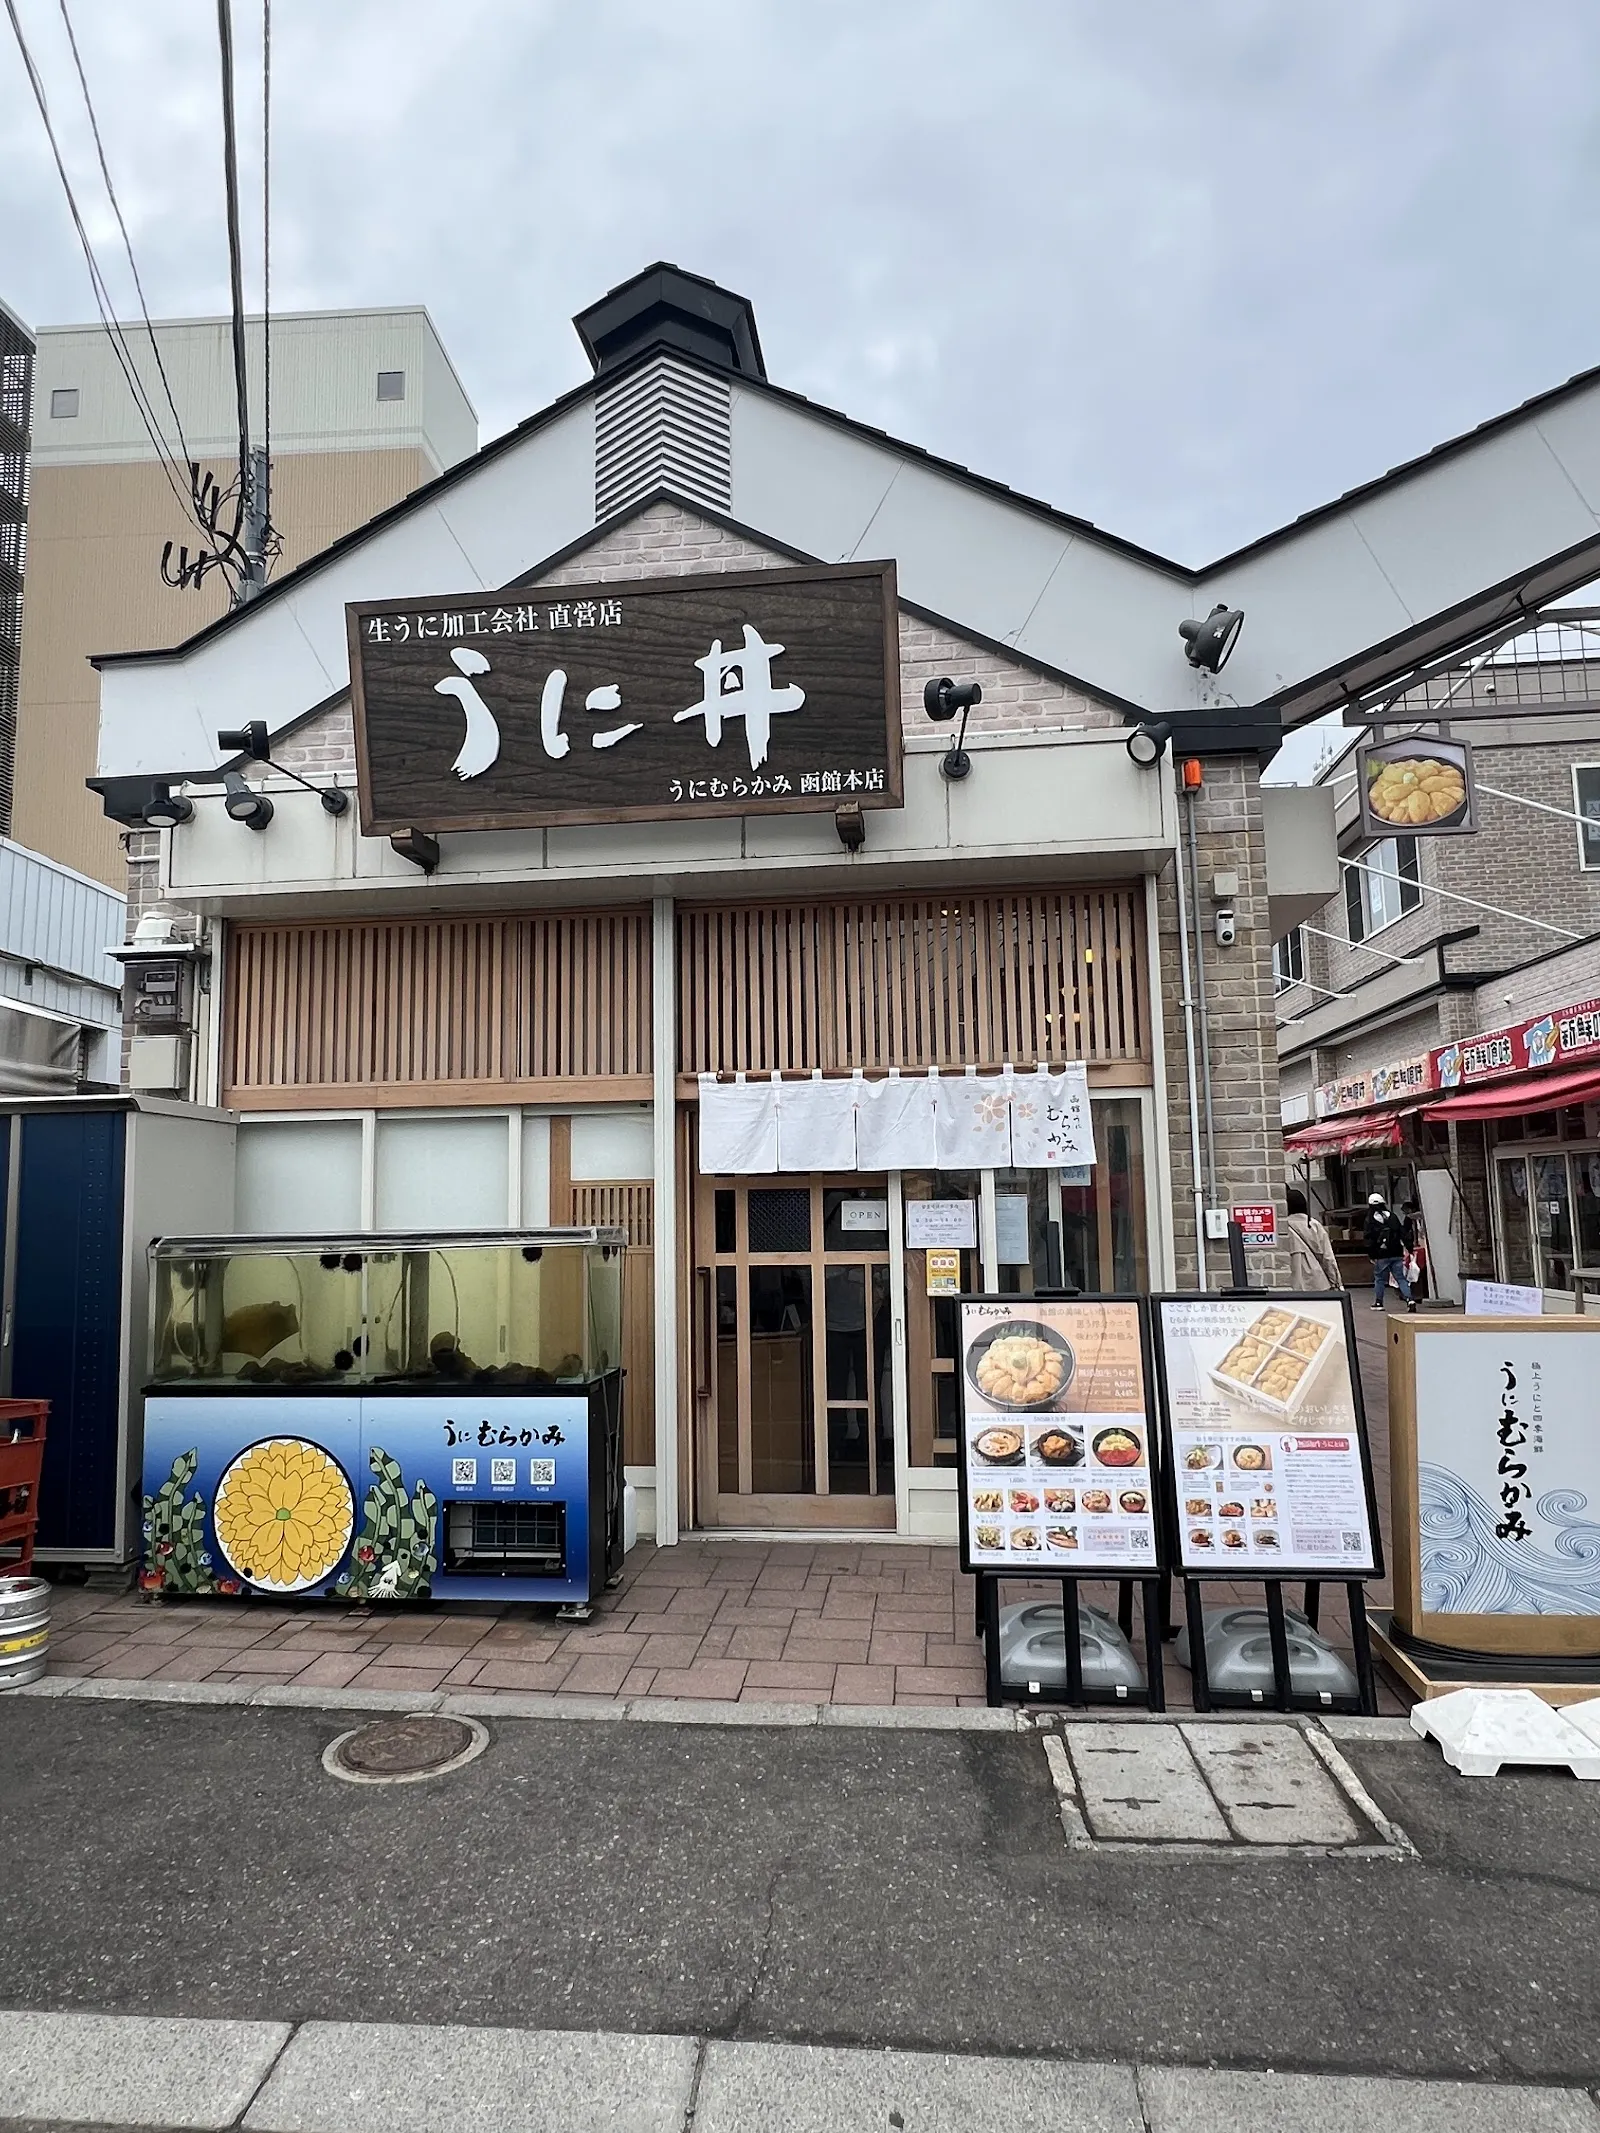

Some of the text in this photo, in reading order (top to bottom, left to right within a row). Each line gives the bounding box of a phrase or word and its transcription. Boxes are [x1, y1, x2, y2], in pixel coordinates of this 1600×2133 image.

[367, 600, 623, 643] 生うに加工会社 直営店
[433, 623, 806, 781] うに丼
[668, 768, 885, 802] うにむらかみ 函館本店
[849, 1211, 881, 1219] OPEN
[1242, 1233, 1274, 1243] ECOM
[1167, 1304, 1246, 1313] ここでしか買えない
[1531, 1362, 1543, 1453] 極上うにと四季海鮮
[444, 1419, 566, 1447] うにむらかみ
[1496, 1362, 1532, 1542] うにむらかみ
